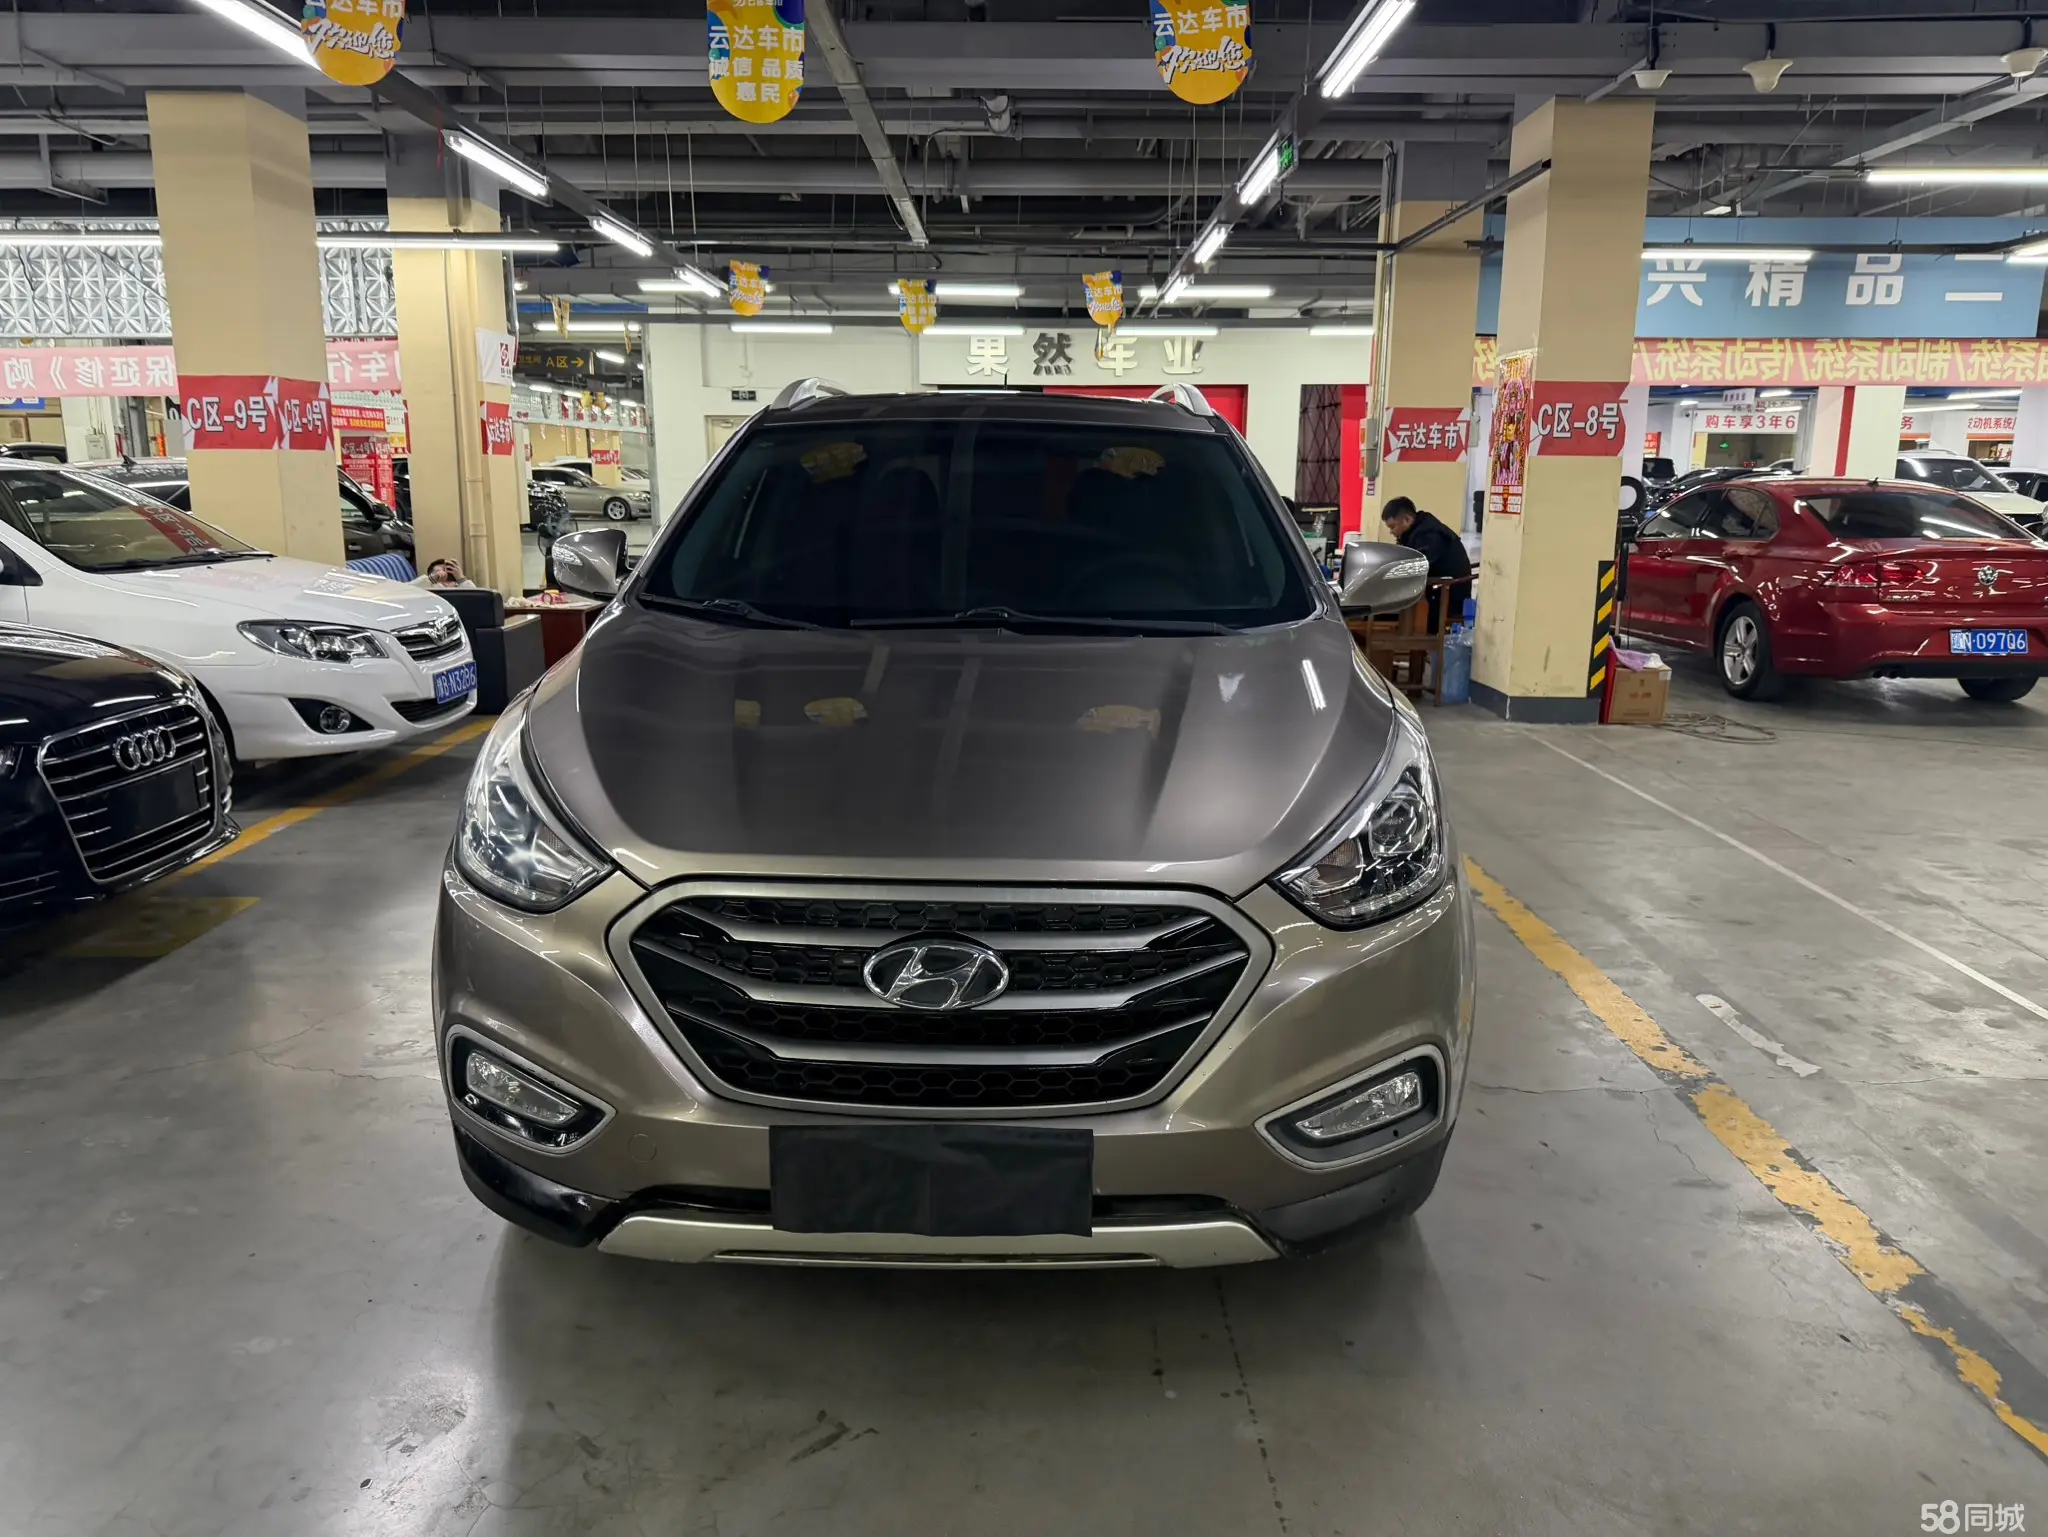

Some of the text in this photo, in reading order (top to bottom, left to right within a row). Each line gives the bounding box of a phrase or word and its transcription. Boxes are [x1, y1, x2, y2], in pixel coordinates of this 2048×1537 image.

[1153, 4, 1248, 37] 云达车市
[306, 18, 396, 59] 欢迎您
[708, 24, 805, 53] 云达车市
[709, 56, 804, 81] 诚信 品质
[1160, 35, 1246, 84] 欢迎您
[736, 81, 781, 104] 惠民
[546, 355, 569, 369] A区
[966, 332, 1205, 377] 果然车业
[186, 395, 269, 434] C区-9号
[284, 398, 324, 436] C区-9号
[1536, 402, 1620, 440] C区-8号
[1704, 414, 1796, 430] 购车享3年6
[1900, 415, 1914, 431] 务
[1396, 421, 1461, 450] 云达车市
